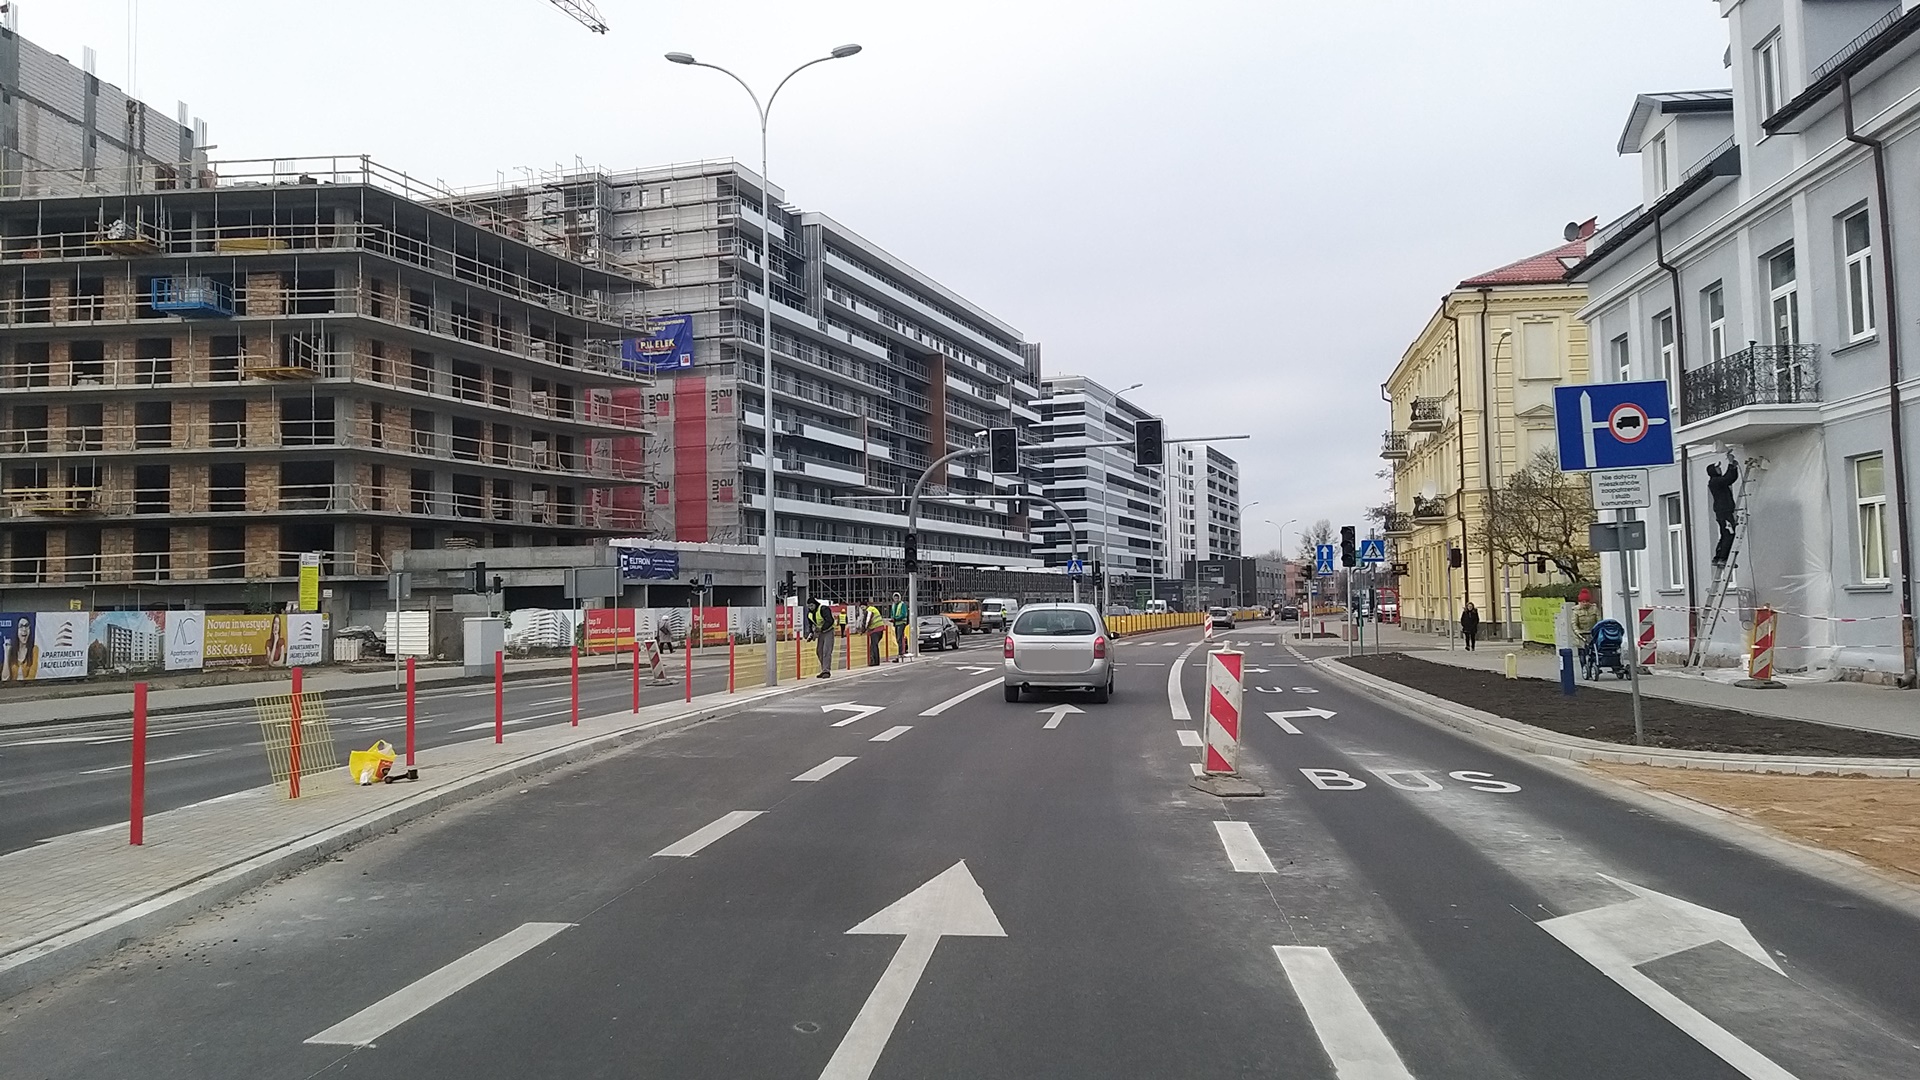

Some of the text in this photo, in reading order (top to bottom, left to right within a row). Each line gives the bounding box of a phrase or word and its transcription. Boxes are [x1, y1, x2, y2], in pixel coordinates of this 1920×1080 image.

[655, 338, 675, 348] ELEK
[648, 438, 671, 458] Life
[710, 436, 733, 456] Life
[629, 557, 650, 565] ELTRON
[206, 618, 271, 631] Nowa inwestycja
[41, 650, 84, 659] APARTAMENTY
[170, 649, 199, 657] Apartamenty
[206, 643, 252, 656] 885 604 614
[40, 659, 84, 669] JAGIELLOŃSKIE
[1299, 768, 1522, 793] BUS
